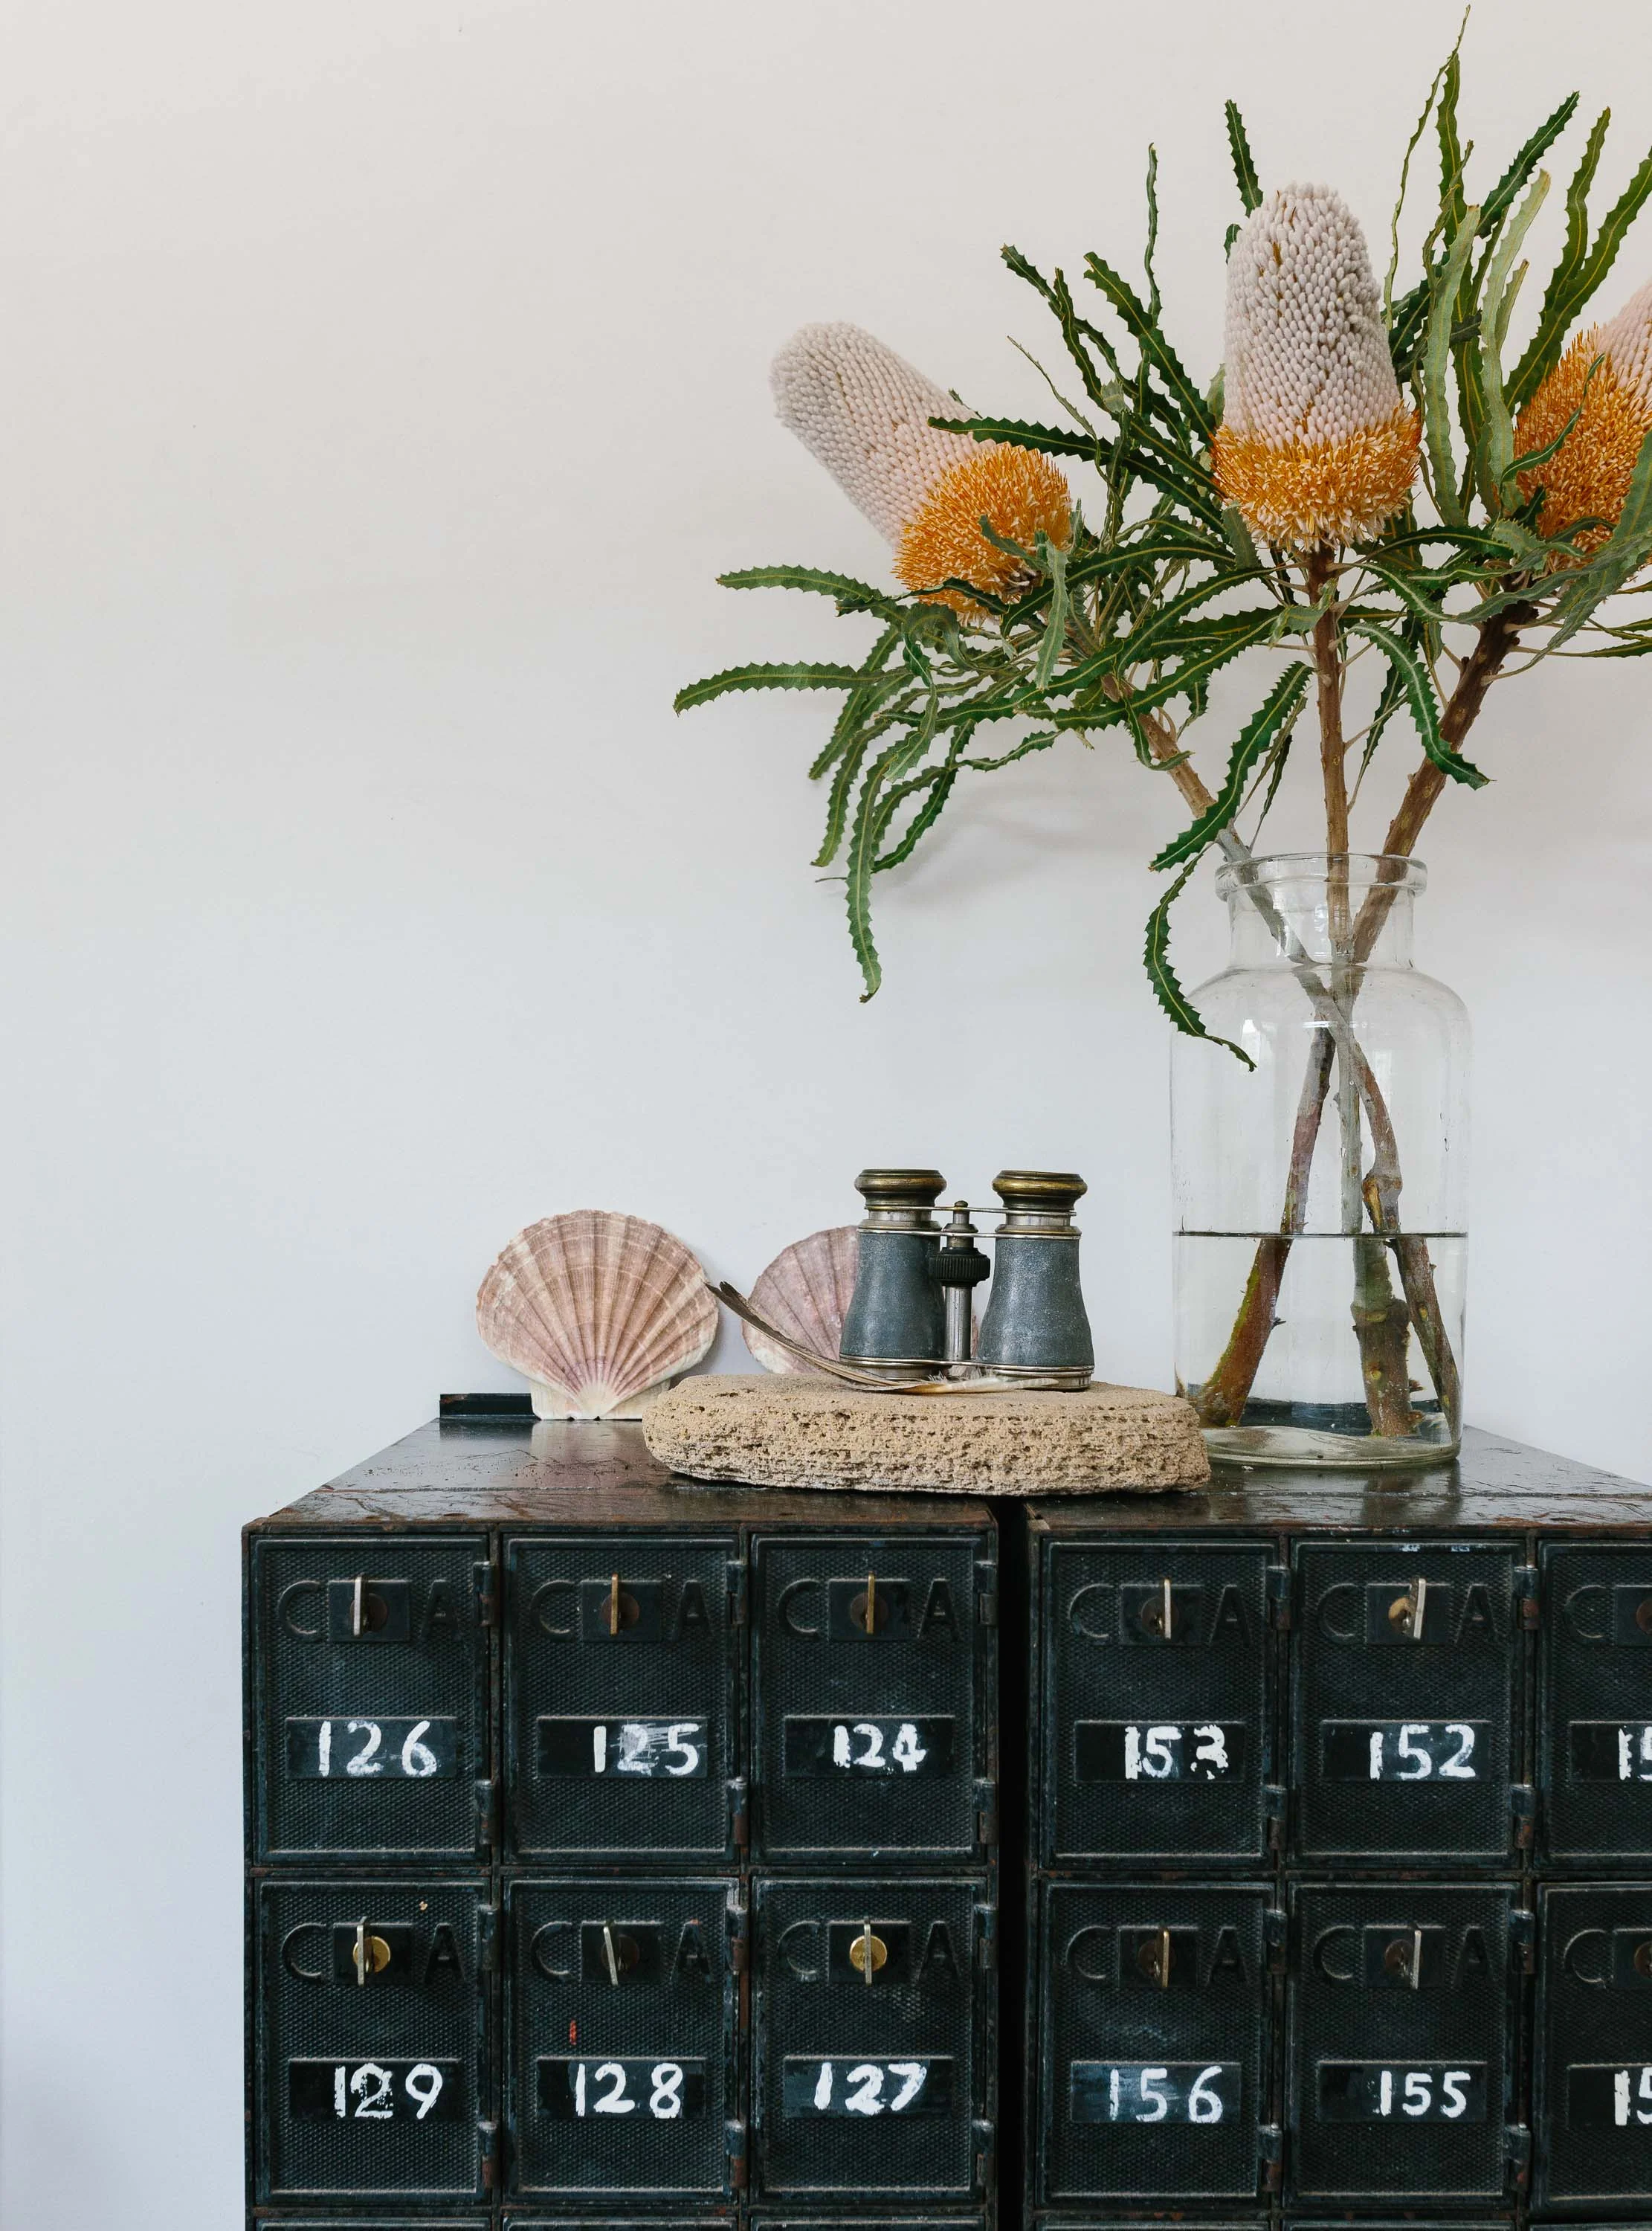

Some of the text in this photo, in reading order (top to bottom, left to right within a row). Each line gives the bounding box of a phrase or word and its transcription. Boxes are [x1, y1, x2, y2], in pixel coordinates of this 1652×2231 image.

[278, 1579, 462, 1643] C A
[529, 1579, 715, 1643] C A
[777, 1577, 959, 1641] C A
[1068, 1583, 1253, 1644] C A
[1315, 1583, 1501, 1644] C A
[1564, 1584, 1610, 1644] C
[319, 1720, 436, 1778] 126
[593, 1721, 700, 1778] 125
[833, 1722, 928, 1772] 124
[1125, 1724, 1229, 1780] 153
[1369, 1724, 1476, 1780] 152
[280, 1922, 469, 1985] C A
[529, 1919, 715, 1984] C A
[777, 1920, 961, 1983] C A
[1065, 1925, 1250, 1986] C A
[1313, 1925, 1498, 1987] C A
[1562, 1929, 1608, 1987] C
[334, 2062, 444, 2120] 129
[575, 2061, 684, 2119] 128
[813, 2061, 927, 2116] 127
[1109, 2064, 1224, 2124] 156
[1379, 2070, 1471, 2118] 155
